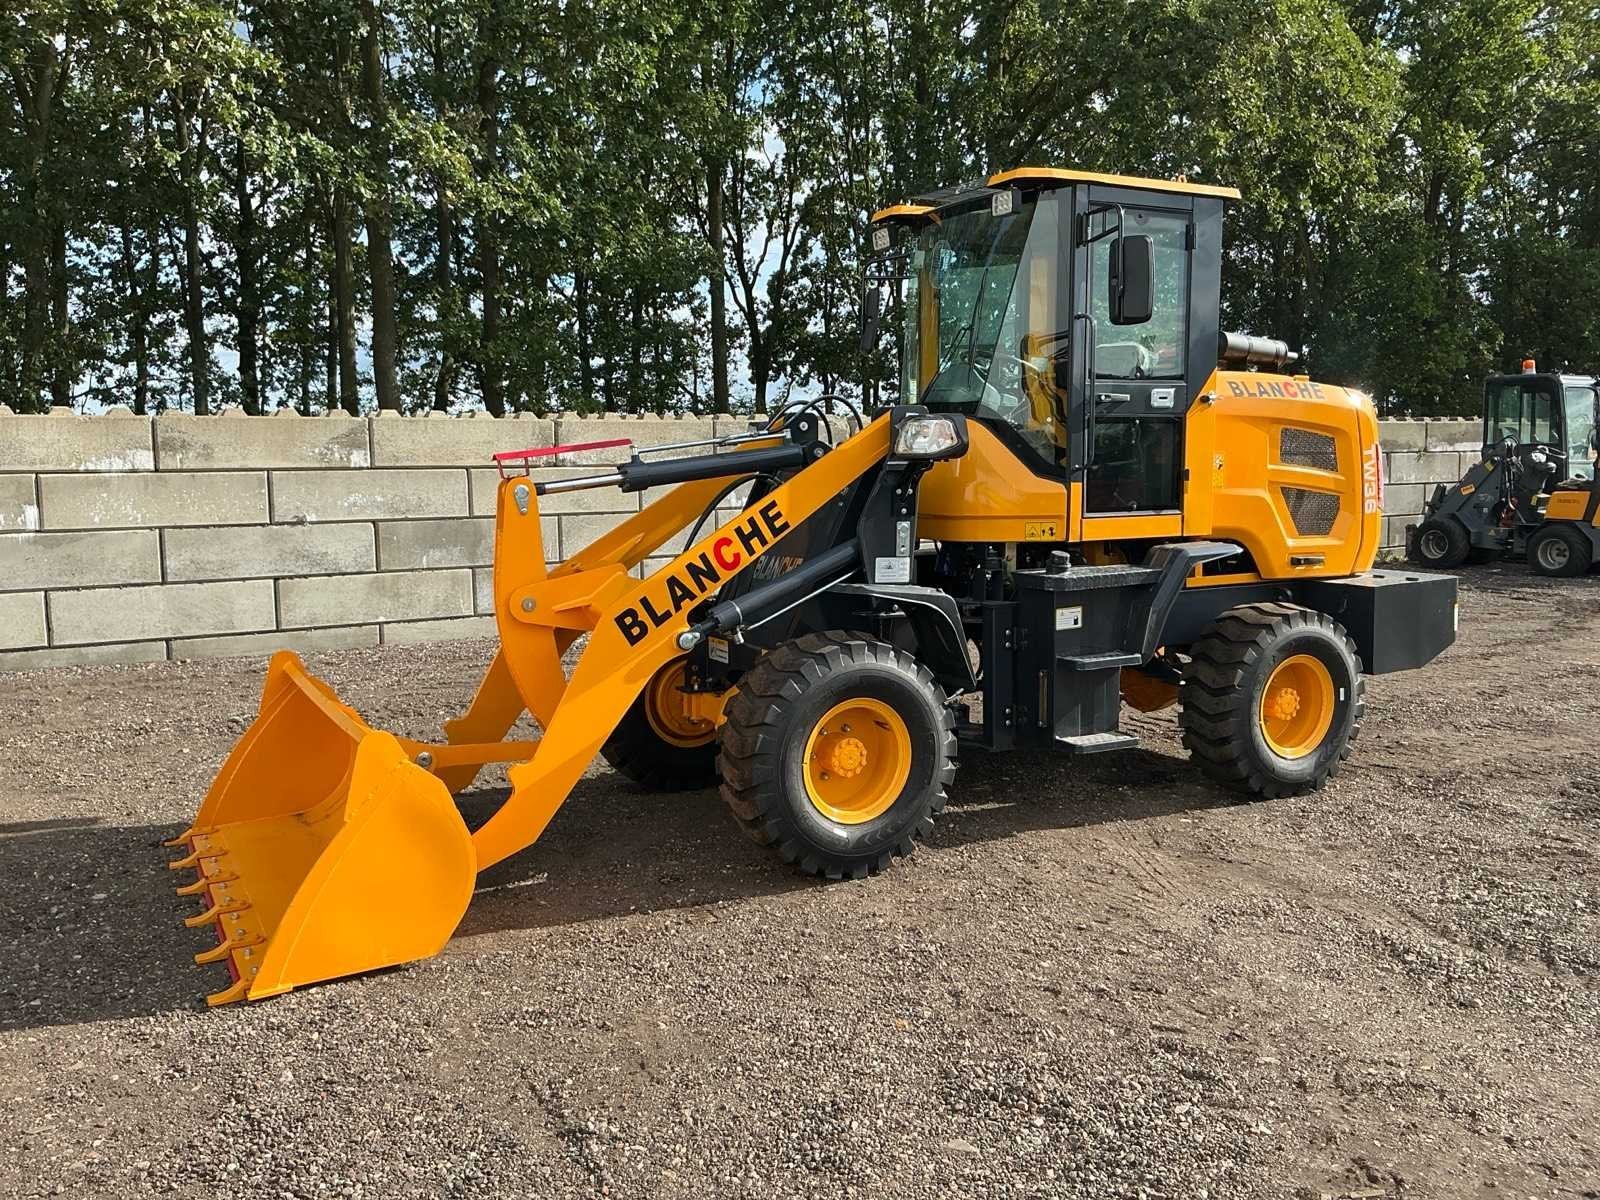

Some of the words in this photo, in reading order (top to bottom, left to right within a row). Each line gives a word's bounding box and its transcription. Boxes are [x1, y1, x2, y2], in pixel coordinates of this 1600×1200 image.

[1226, 381, 1326, 400] BLANCHE
[1363, 444, 1377, 514] TW36
[614, 500, 790, 647] BLANCHE
